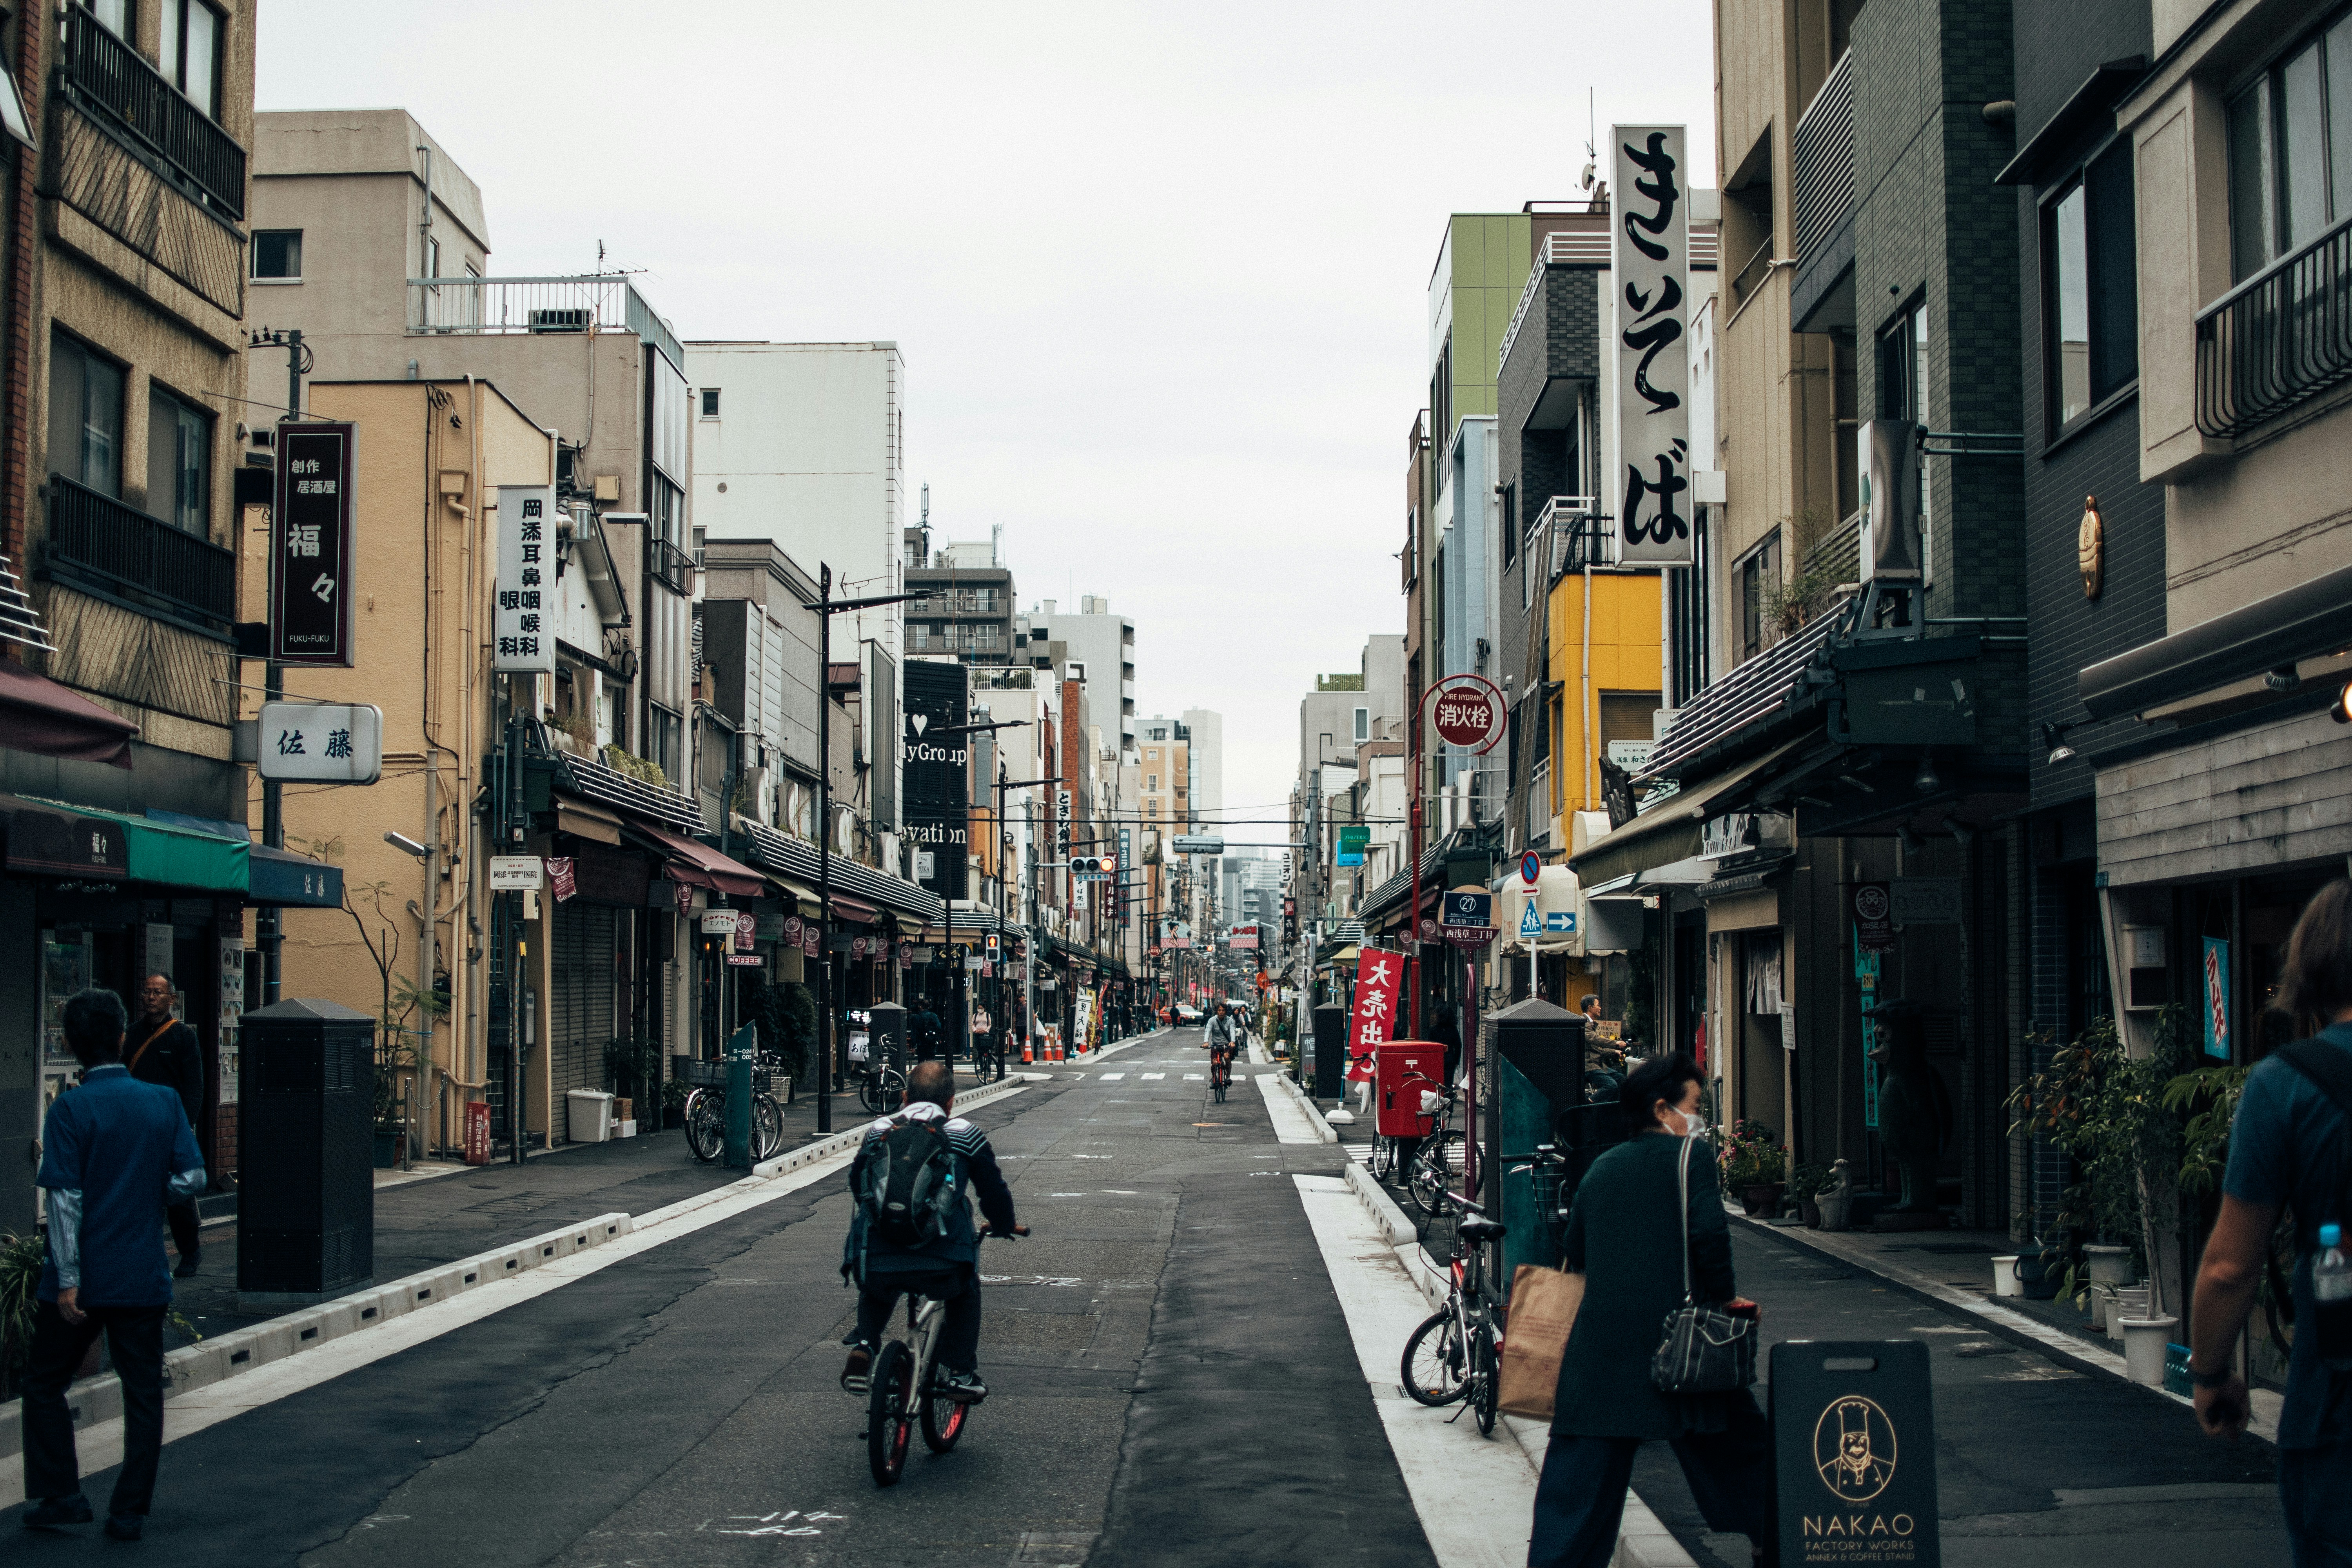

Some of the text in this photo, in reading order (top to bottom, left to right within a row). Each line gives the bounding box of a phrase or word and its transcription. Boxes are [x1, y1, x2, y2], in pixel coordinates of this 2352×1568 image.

[291, 459, 320, 474] 創作
[297, 480, 336, 494] 居酒屋
[288, 524, 336, 603] 福々
[520, 499, 543, 657] 岡添耳鼻咽喉科
[499, 590, 520, 657] 眼科
[289, 635, 330, 643] FUKU-FUKU
[1439, 704, 1489, 728] 消火栓
[277, 730, 354, 758] 佐藤
[93, 832, 106, 853] 福々
[1462, 898, 1474, 910] 27
[1446, 929, 1492, 939] 西浅草三丁目
[728, 956, 759, 964] COFFEE
[2207, 951, 2224, 1038] ラムネ
[1804, 1514, 1914, 1536] NAKAO
[1806, 1541, 1914, 1551] FACTORY WORKS
[1849, 1553, 1882, 1561] COFFEE
[1885, 1552, 1915, 1561] STAND
